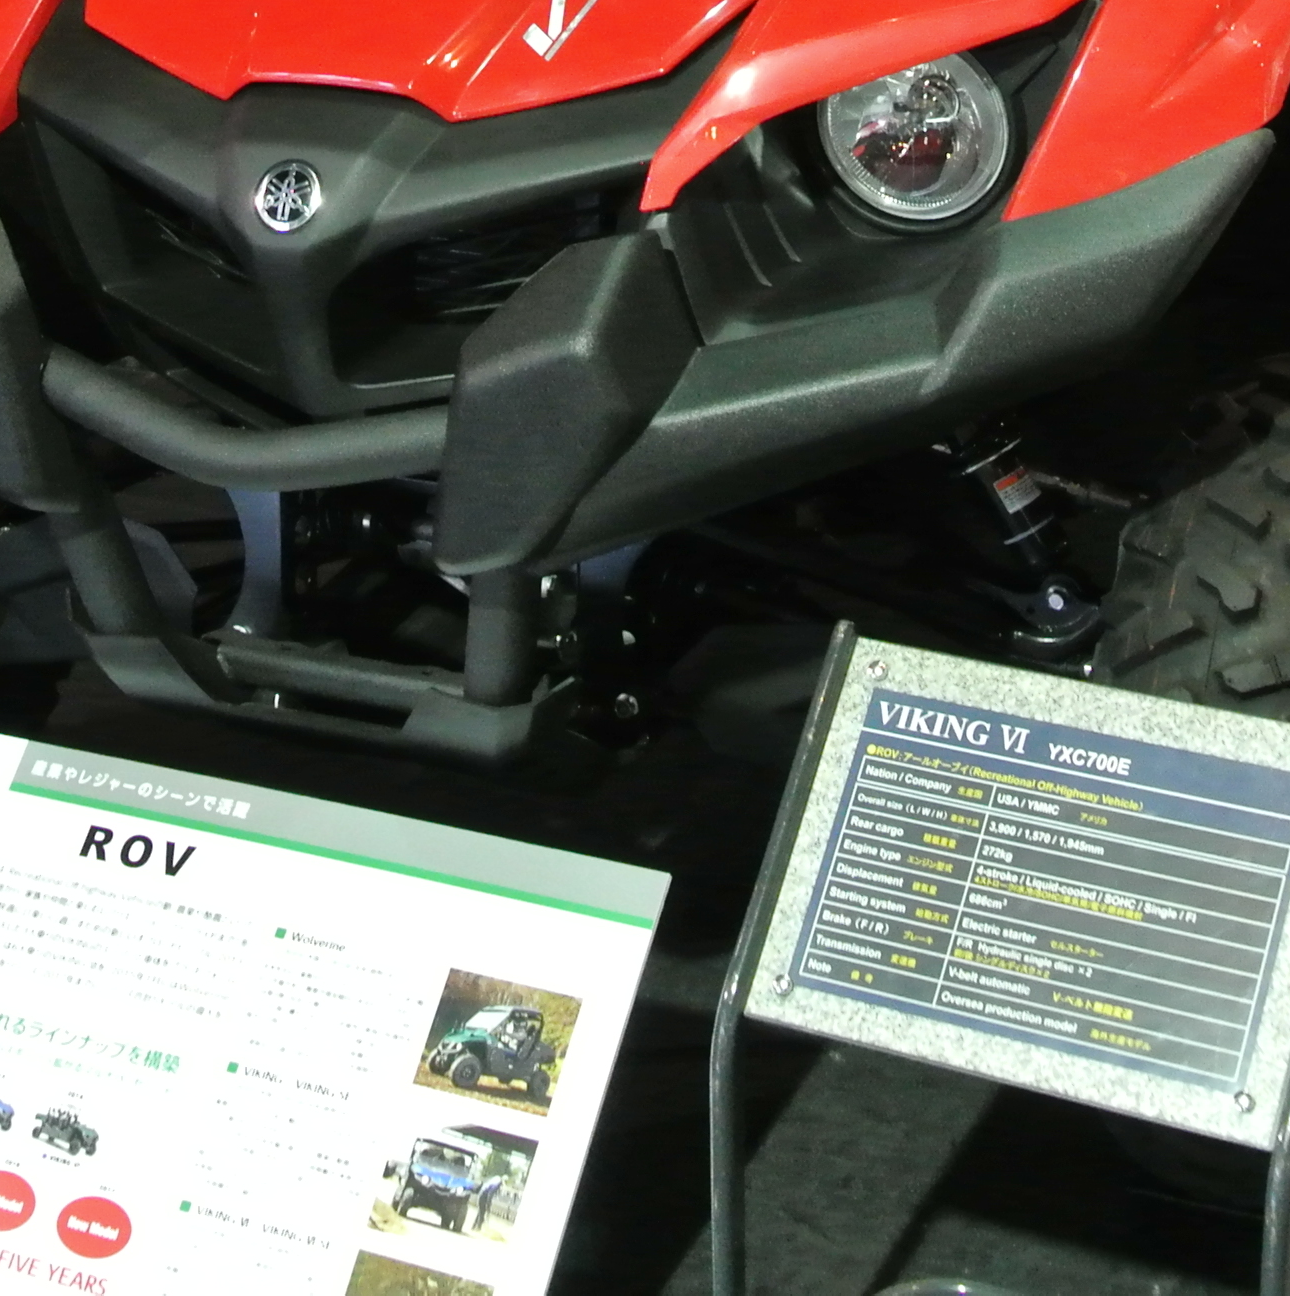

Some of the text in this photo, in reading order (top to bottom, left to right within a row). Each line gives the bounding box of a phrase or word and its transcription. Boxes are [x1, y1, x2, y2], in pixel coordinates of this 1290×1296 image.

[879, 700, 1132, 777] VIKING VI YXC700E
[31, 759, 251, 819] 産業やレジャーのシーンで活躍
[865, 764, 952, 794] Nation Company
[857, 793, 886, 806] Overall
[887, 800, 903, 811] size
[997, 793, 1019, 808] USA
[1027, 799, 1060, 816] YMMC
[1037, 781, 1100, 804] Off-Highway
[850, 815, 904, 837] Rear cargo
[989, 820, 1016, 837] 3,900
[79, 824, 197, 877] ROV
[843, 838, 901, 861] Engine type
[982, 845, 1013, 863] 272kg
[836, 862, 904, 888] Displacement
[829, 886, 906, 914] Starting system
[976, 864, 1018, 884] 4-stroke
[1025, 876, 1097, 902] Liquid-cooled
[1104, 893, 1137, 910] SOHC
[1144, 902, 1178, 920] Single
[822, 910, 852, 926] Brake
[962, 917, 1001, 936] Electric
[1002, 928, 1037, 944] starter
[291, 931, 346, 952] Wolverine
[815, 934, 882, 960] Transmission
[807, 958, 832, 973] Note
[977, 941, 1023, 962] Hydraulic
[1023, 951, 1053, 969] single
[1053, 959, 1074, 974] disc
[948, 966, 1031, 996] V-belt automatic
[941, 990, 1078, 1034] Oversea production model
[48, 1263, 108, 1296] YEARS
